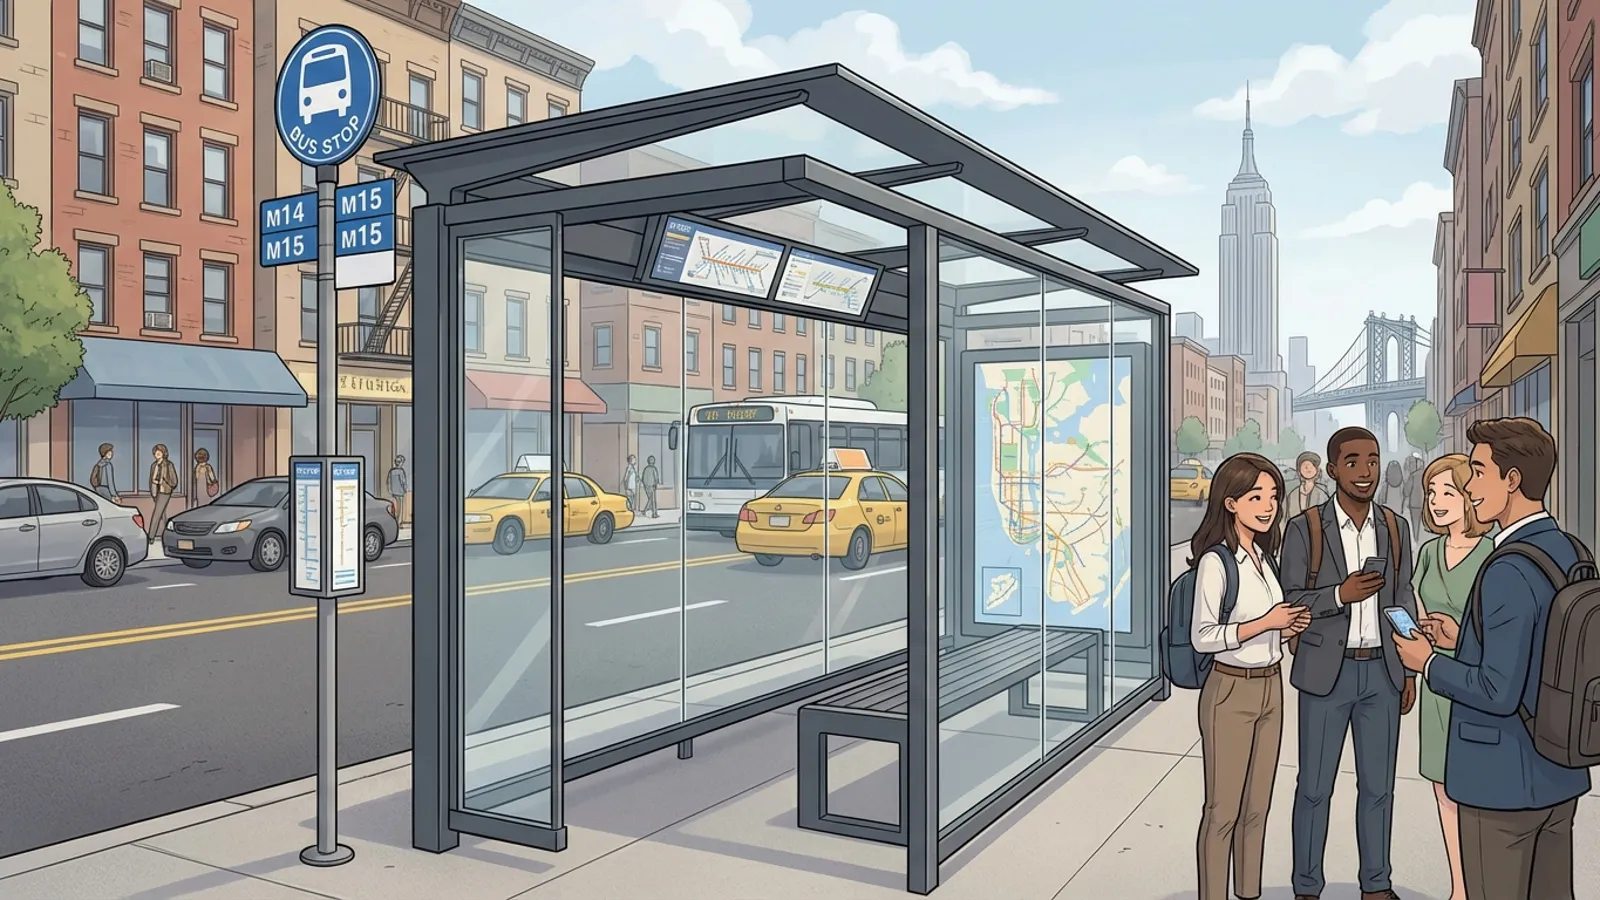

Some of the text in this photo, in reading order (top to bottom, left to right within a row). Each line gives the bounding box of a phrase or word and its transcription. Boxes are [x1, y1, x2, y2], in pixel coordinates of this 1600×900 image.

[290, 115, 359, 155] BUS STOP
[266, 201, 305, 228] M14
[342, 187, 382, 215] M15
[266, 235, 305, 260] M15
[342, 222, 382, 249] M15
